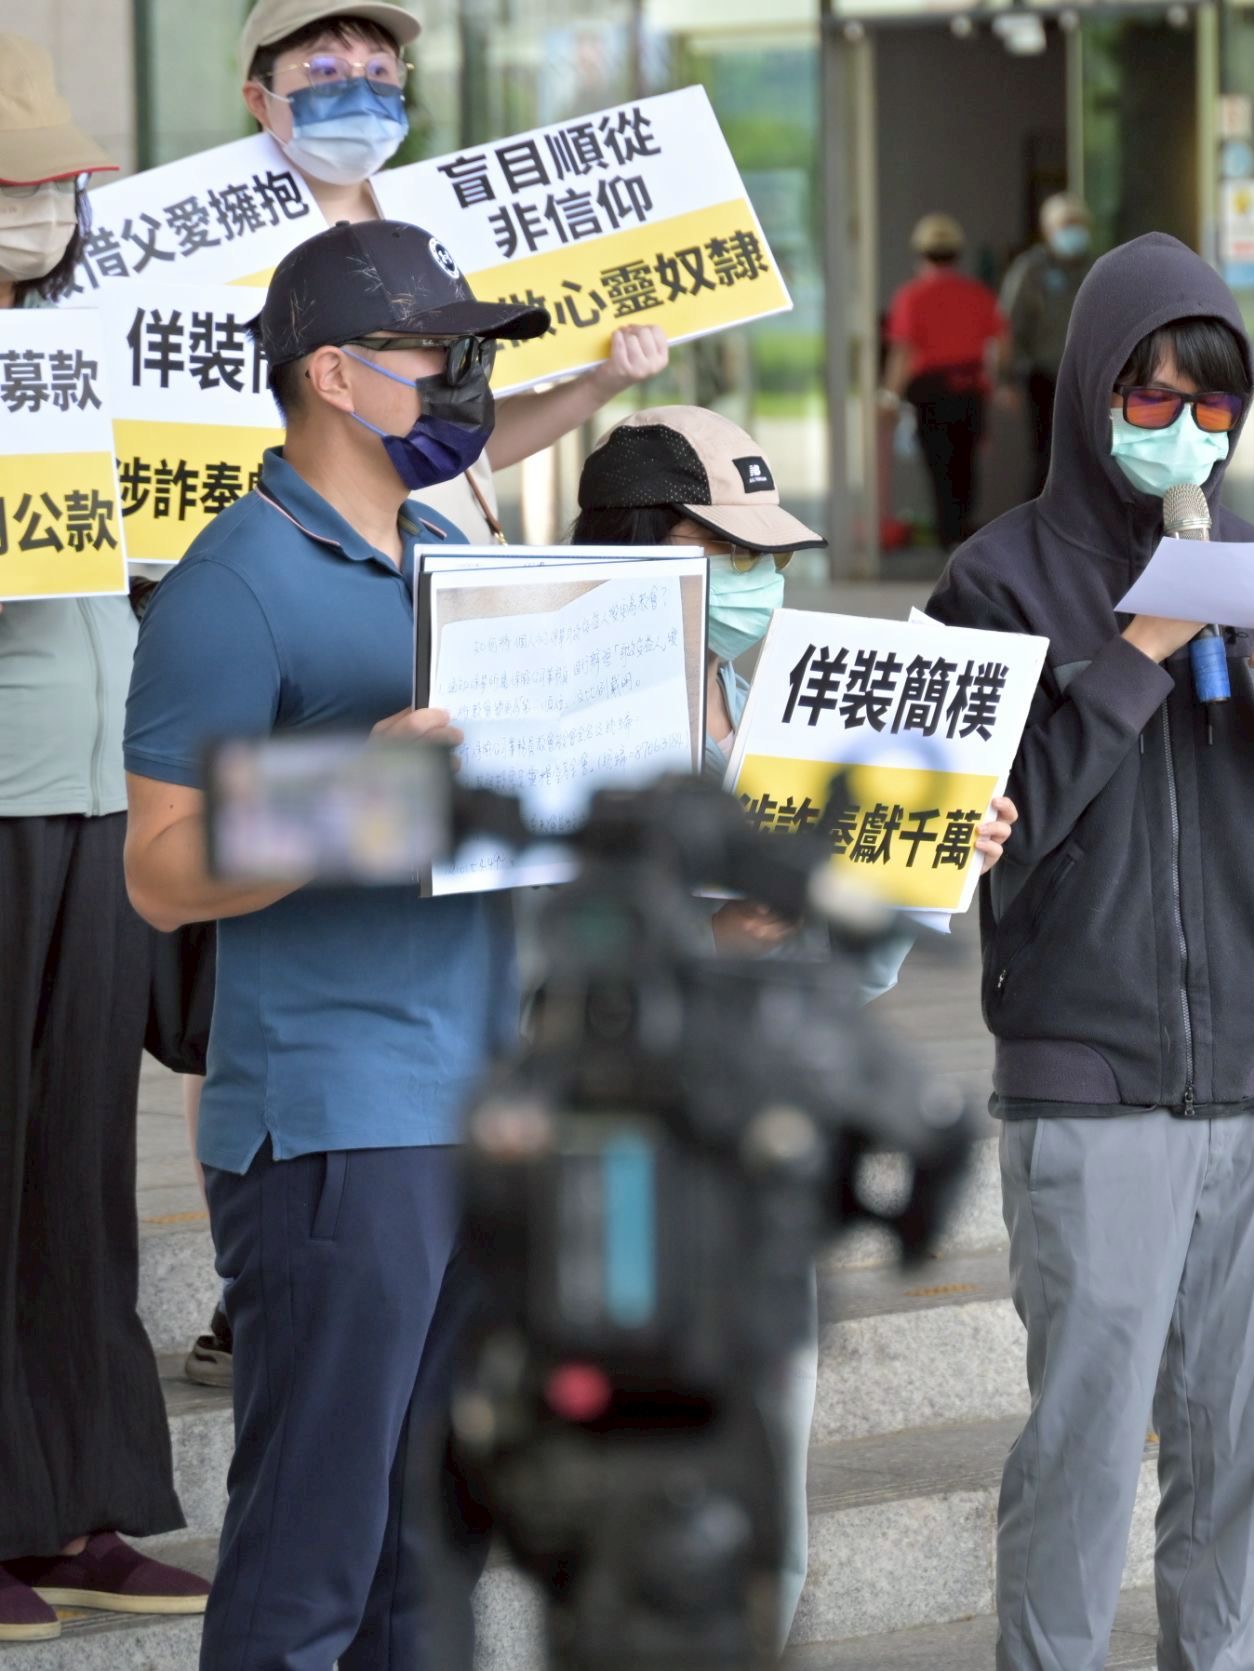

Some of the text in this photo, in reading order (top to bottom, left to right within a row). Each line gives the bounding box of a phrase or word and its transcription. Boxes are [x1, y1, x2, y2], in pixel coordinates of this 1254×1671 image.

[437, 107, 662, 209] 盲目順從
[62, 169, 310, 298] 借父愛擁抱
[487, 174, 654, 258] 非信仰
[496, 229, 770, 349] 心靈奴隸
[0, 349, 103, 413] 募款
[126, 307, 270, 393] 佯裝
[0, 489, 118, 556] 公款
[117, 457, 262, 521] 涉詐奉
[781, 644, 1010, 742] 佯裝簡樸
